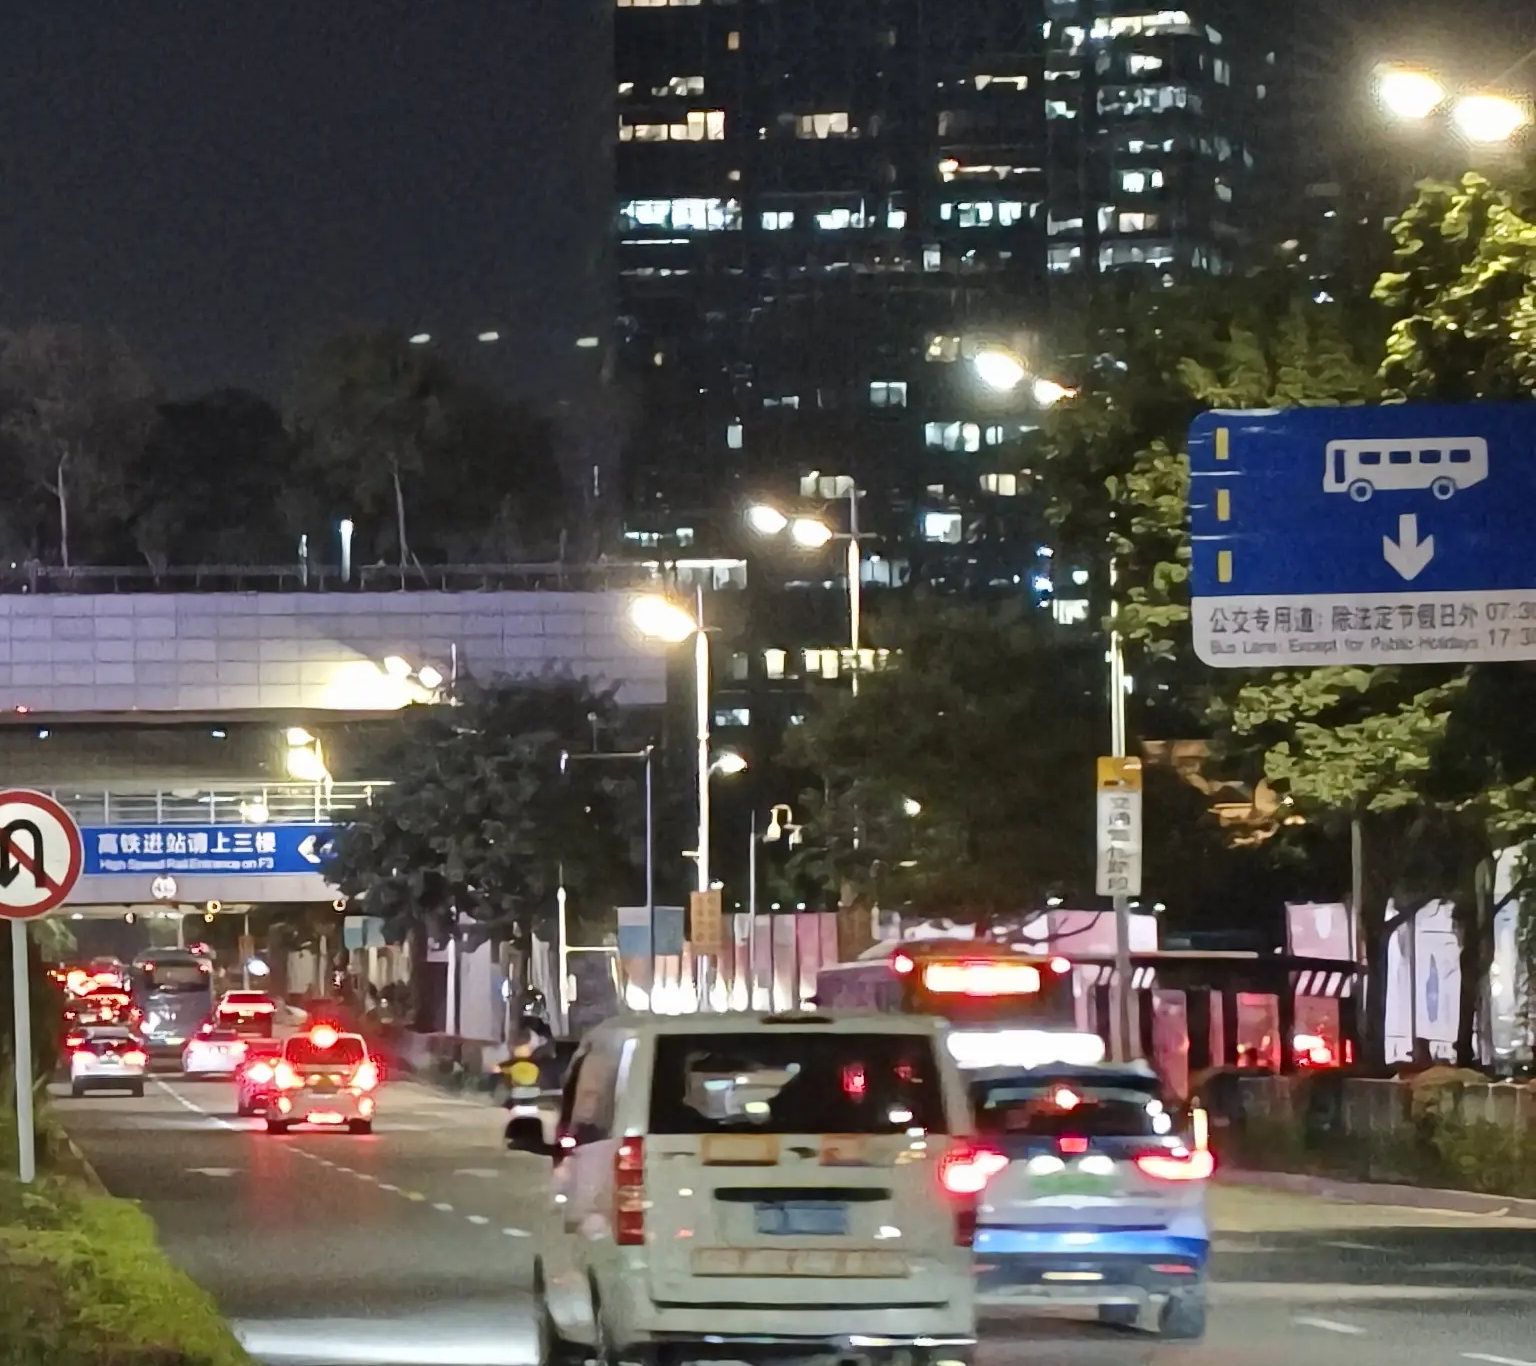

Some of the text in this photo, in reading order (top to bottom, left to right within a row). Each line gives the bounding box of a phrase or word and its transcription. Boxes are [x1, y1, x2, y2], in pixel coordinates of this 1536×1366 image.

[98, 831, 276, 854] 高铁进站请上三楼
